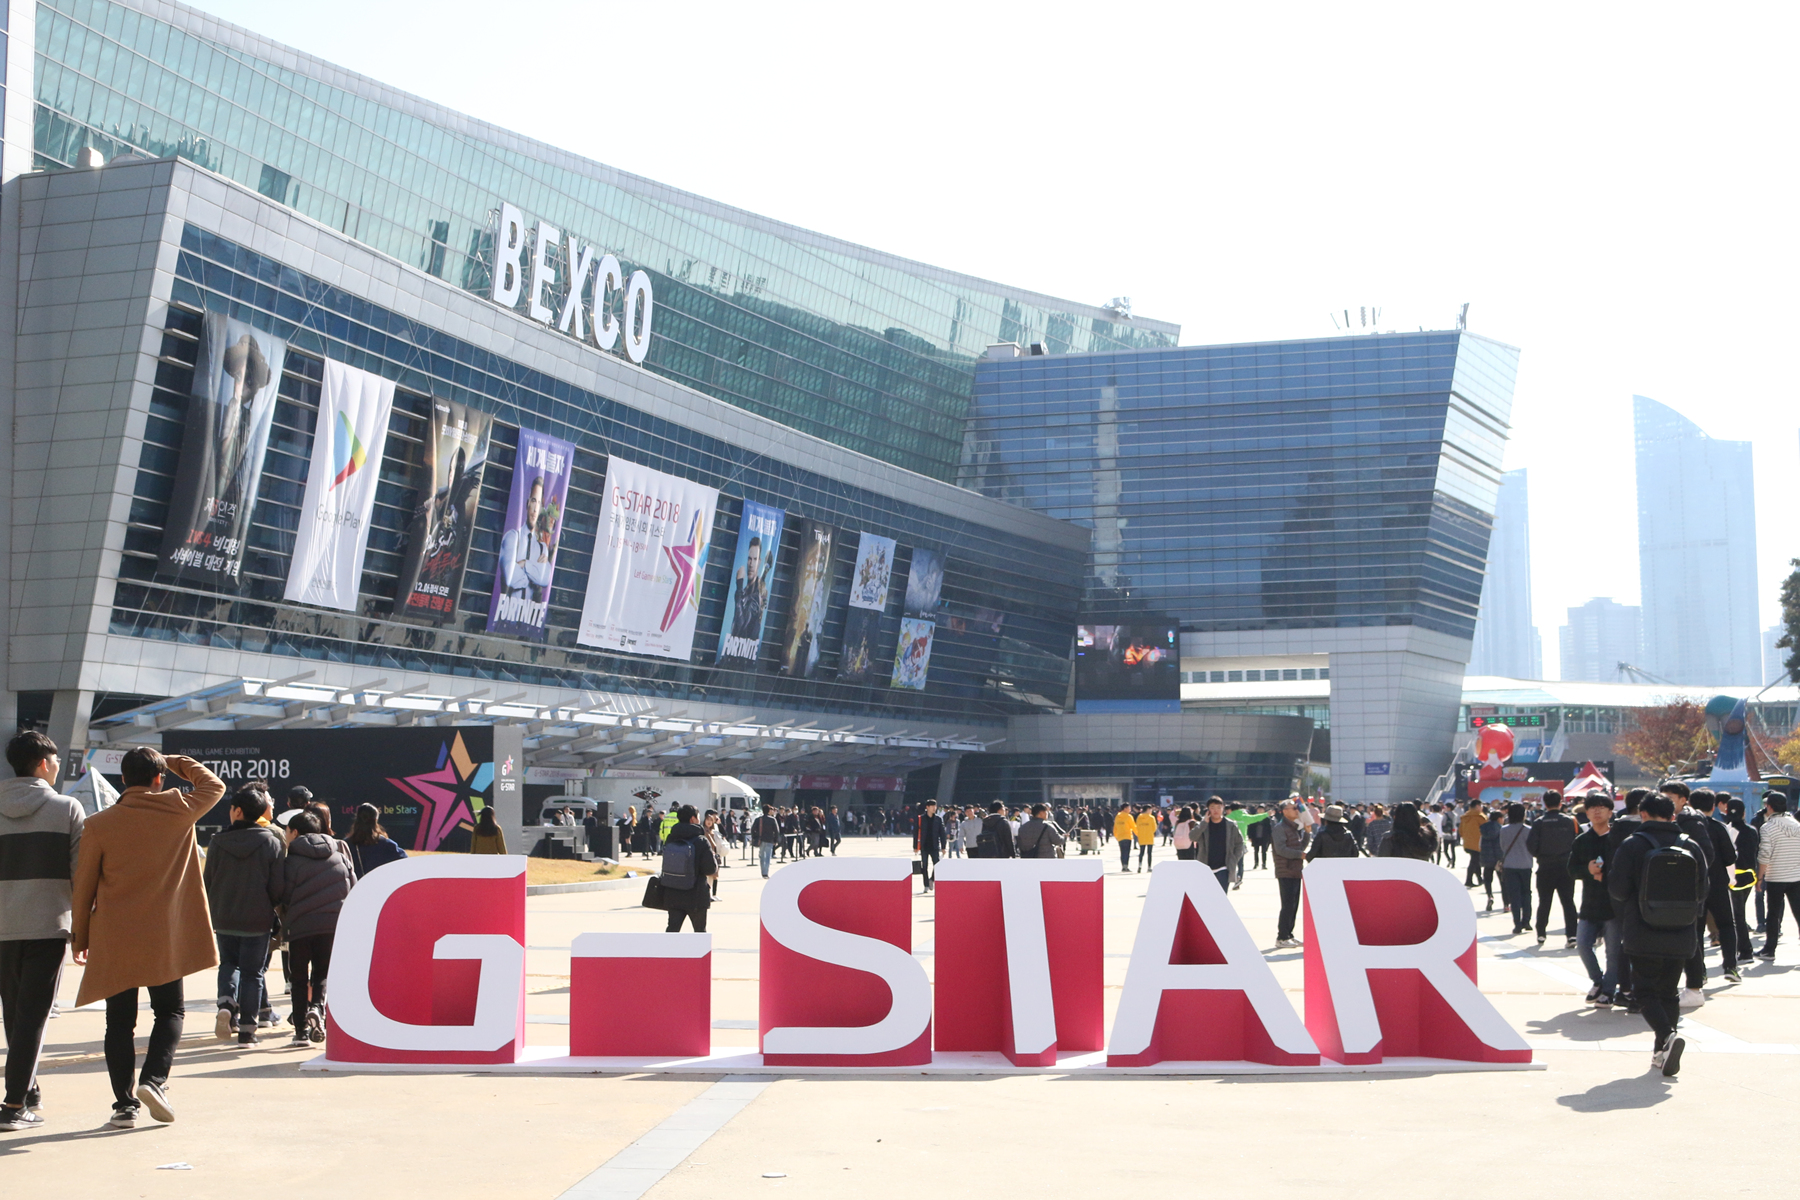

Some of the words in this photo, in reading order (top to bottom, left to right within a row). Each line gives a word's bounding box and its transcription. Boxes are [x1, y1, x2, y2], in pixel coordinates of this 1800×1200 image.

[493, 201, 653, 364] BEXCO
[612, 486, 652, 516] G-STAR
[653, 498, 680, 524] 2018
[316, 504, 343, 528] Google
[343, 510, 363, 534] Play
[170, 547, 204, 568] 서바이벌
[204, 554, 224, 571] 대전
[493, 593, 547, 628] FORTNITE
[721, 633, 759, 661] FORTNITE
[105, 753, 123, 764] G-ST
[180, 747, 203, 756] GLOBAL
[205, 747, 224, 755] GAME
[225, 746, 260, 755] EXHIBITION
[70, 763, 77, 777] 1
[203, 760, 242, 779] TAR
[246, 759, 290, 779] 2018
[500, 782, 516, 791] G-STAR
[341, 805, 354, 814] Let
[383, 804, 395, 814] be
[395, 804, 418, 815] Stars
[325, 853, 1533, 1064] G-STAR
